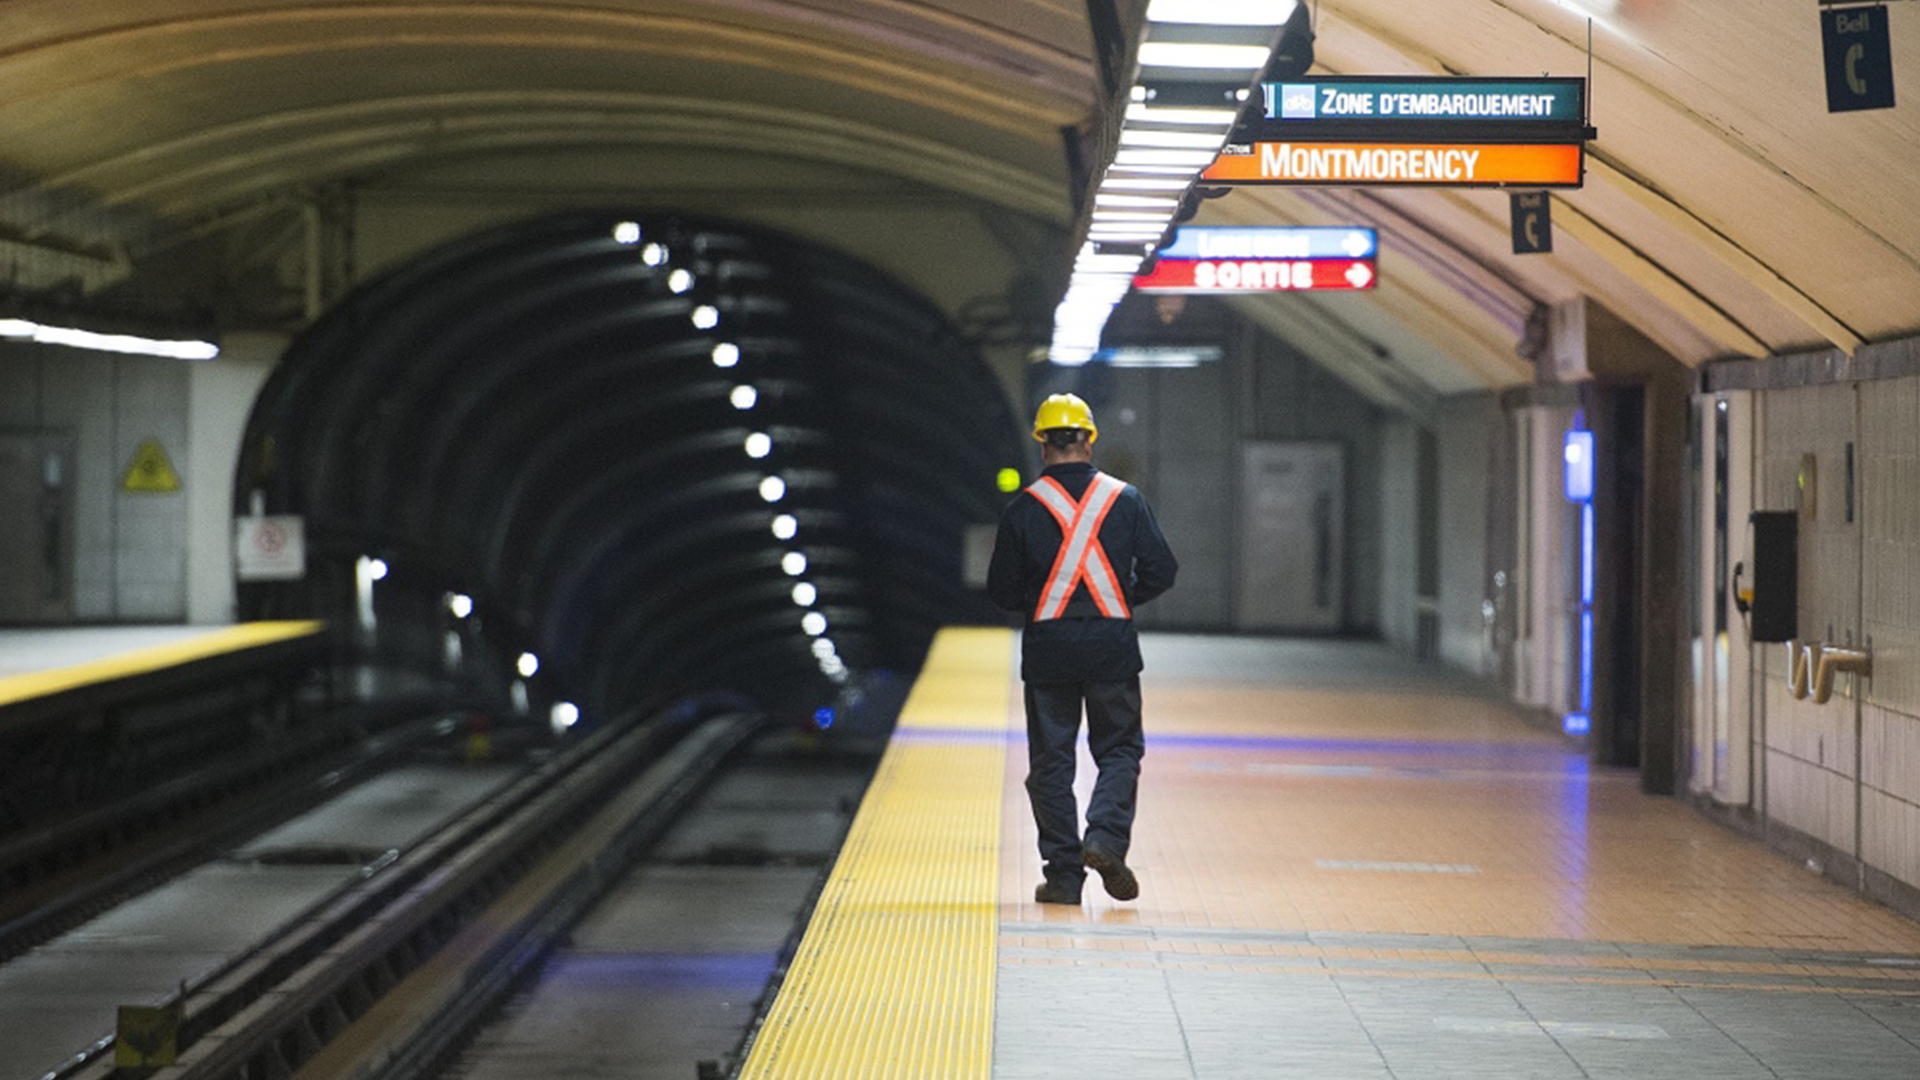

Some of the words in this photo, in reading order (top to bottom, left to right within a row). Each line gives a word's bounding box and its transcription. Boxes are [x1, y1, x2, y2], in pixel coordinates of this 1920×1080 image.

[1836, 12, 1870, 34] Bell
[1321, 88, 1374, 115] ZONE
[1261, 143, 1480, 180] MONTMORENCY
[1194, 262, 1313, 288] SORTIE
